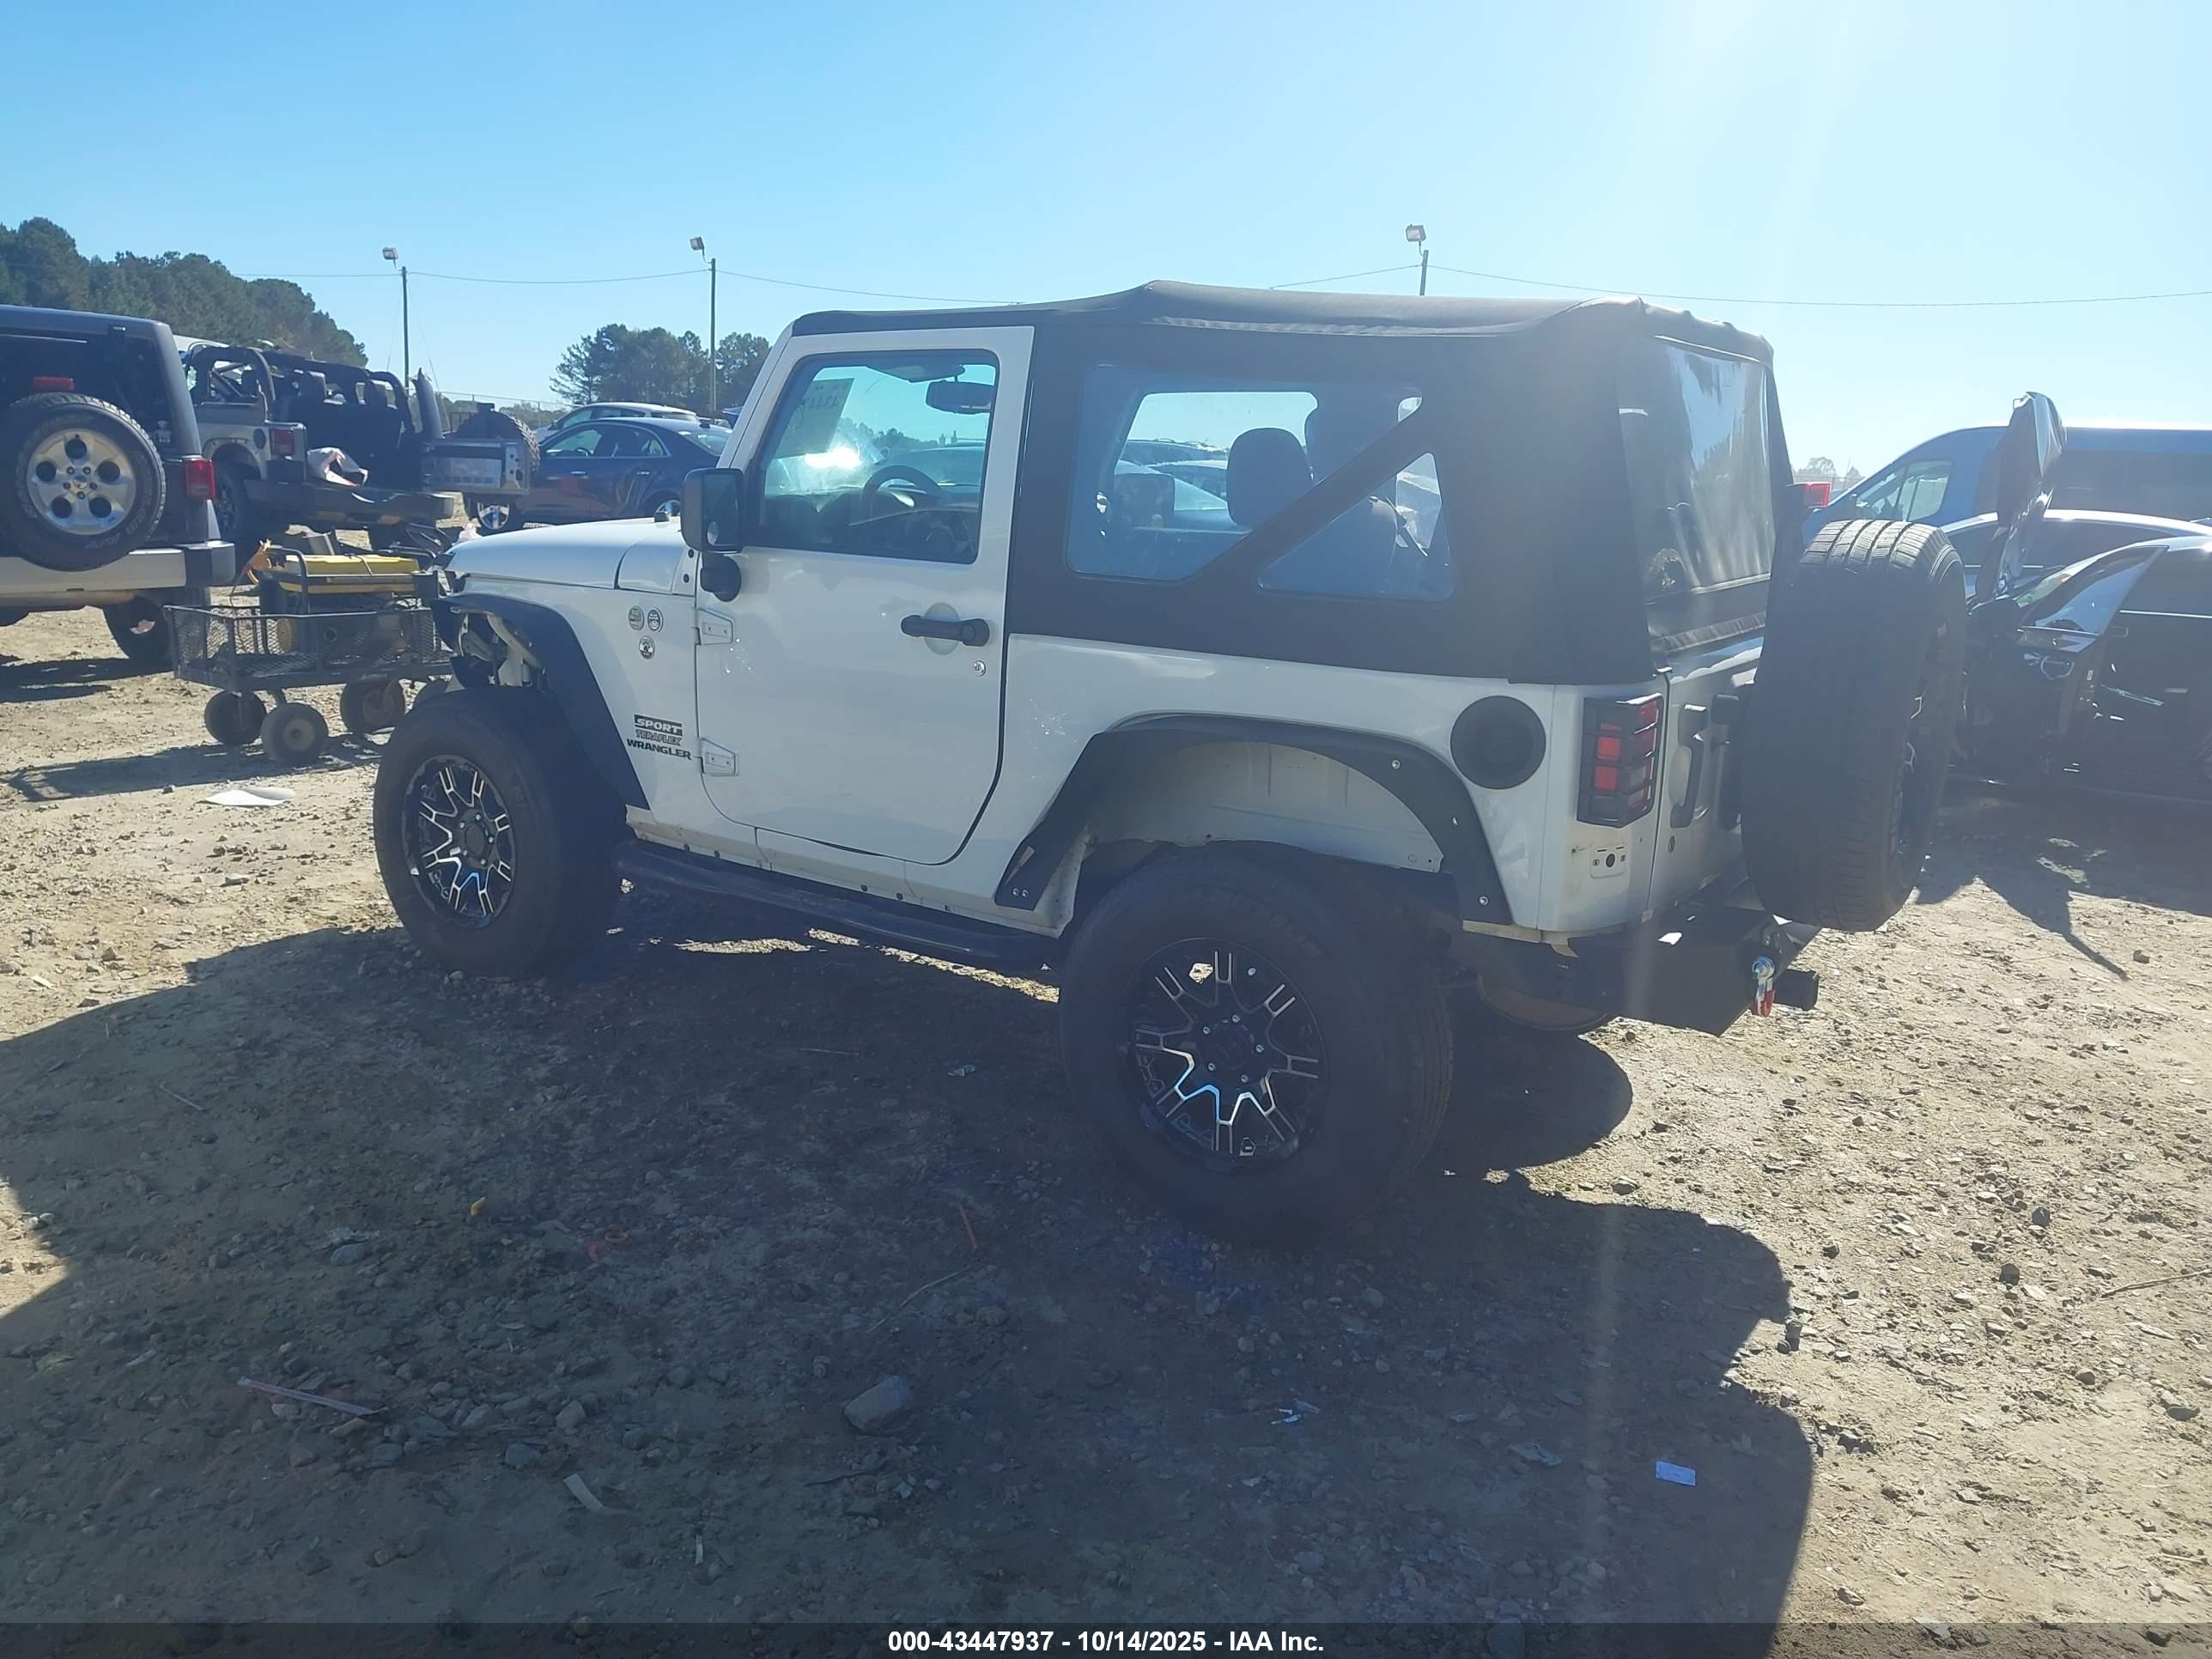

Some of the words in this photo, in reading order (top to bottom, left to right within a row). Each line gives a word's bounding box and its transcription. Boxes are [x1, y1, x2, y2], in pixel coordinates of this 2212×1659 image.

[635, 717, 683, 734] SPORT
[635, 729, 682, 746] TERAFLEX
[626, 738, 692, 761] WRANGLER
